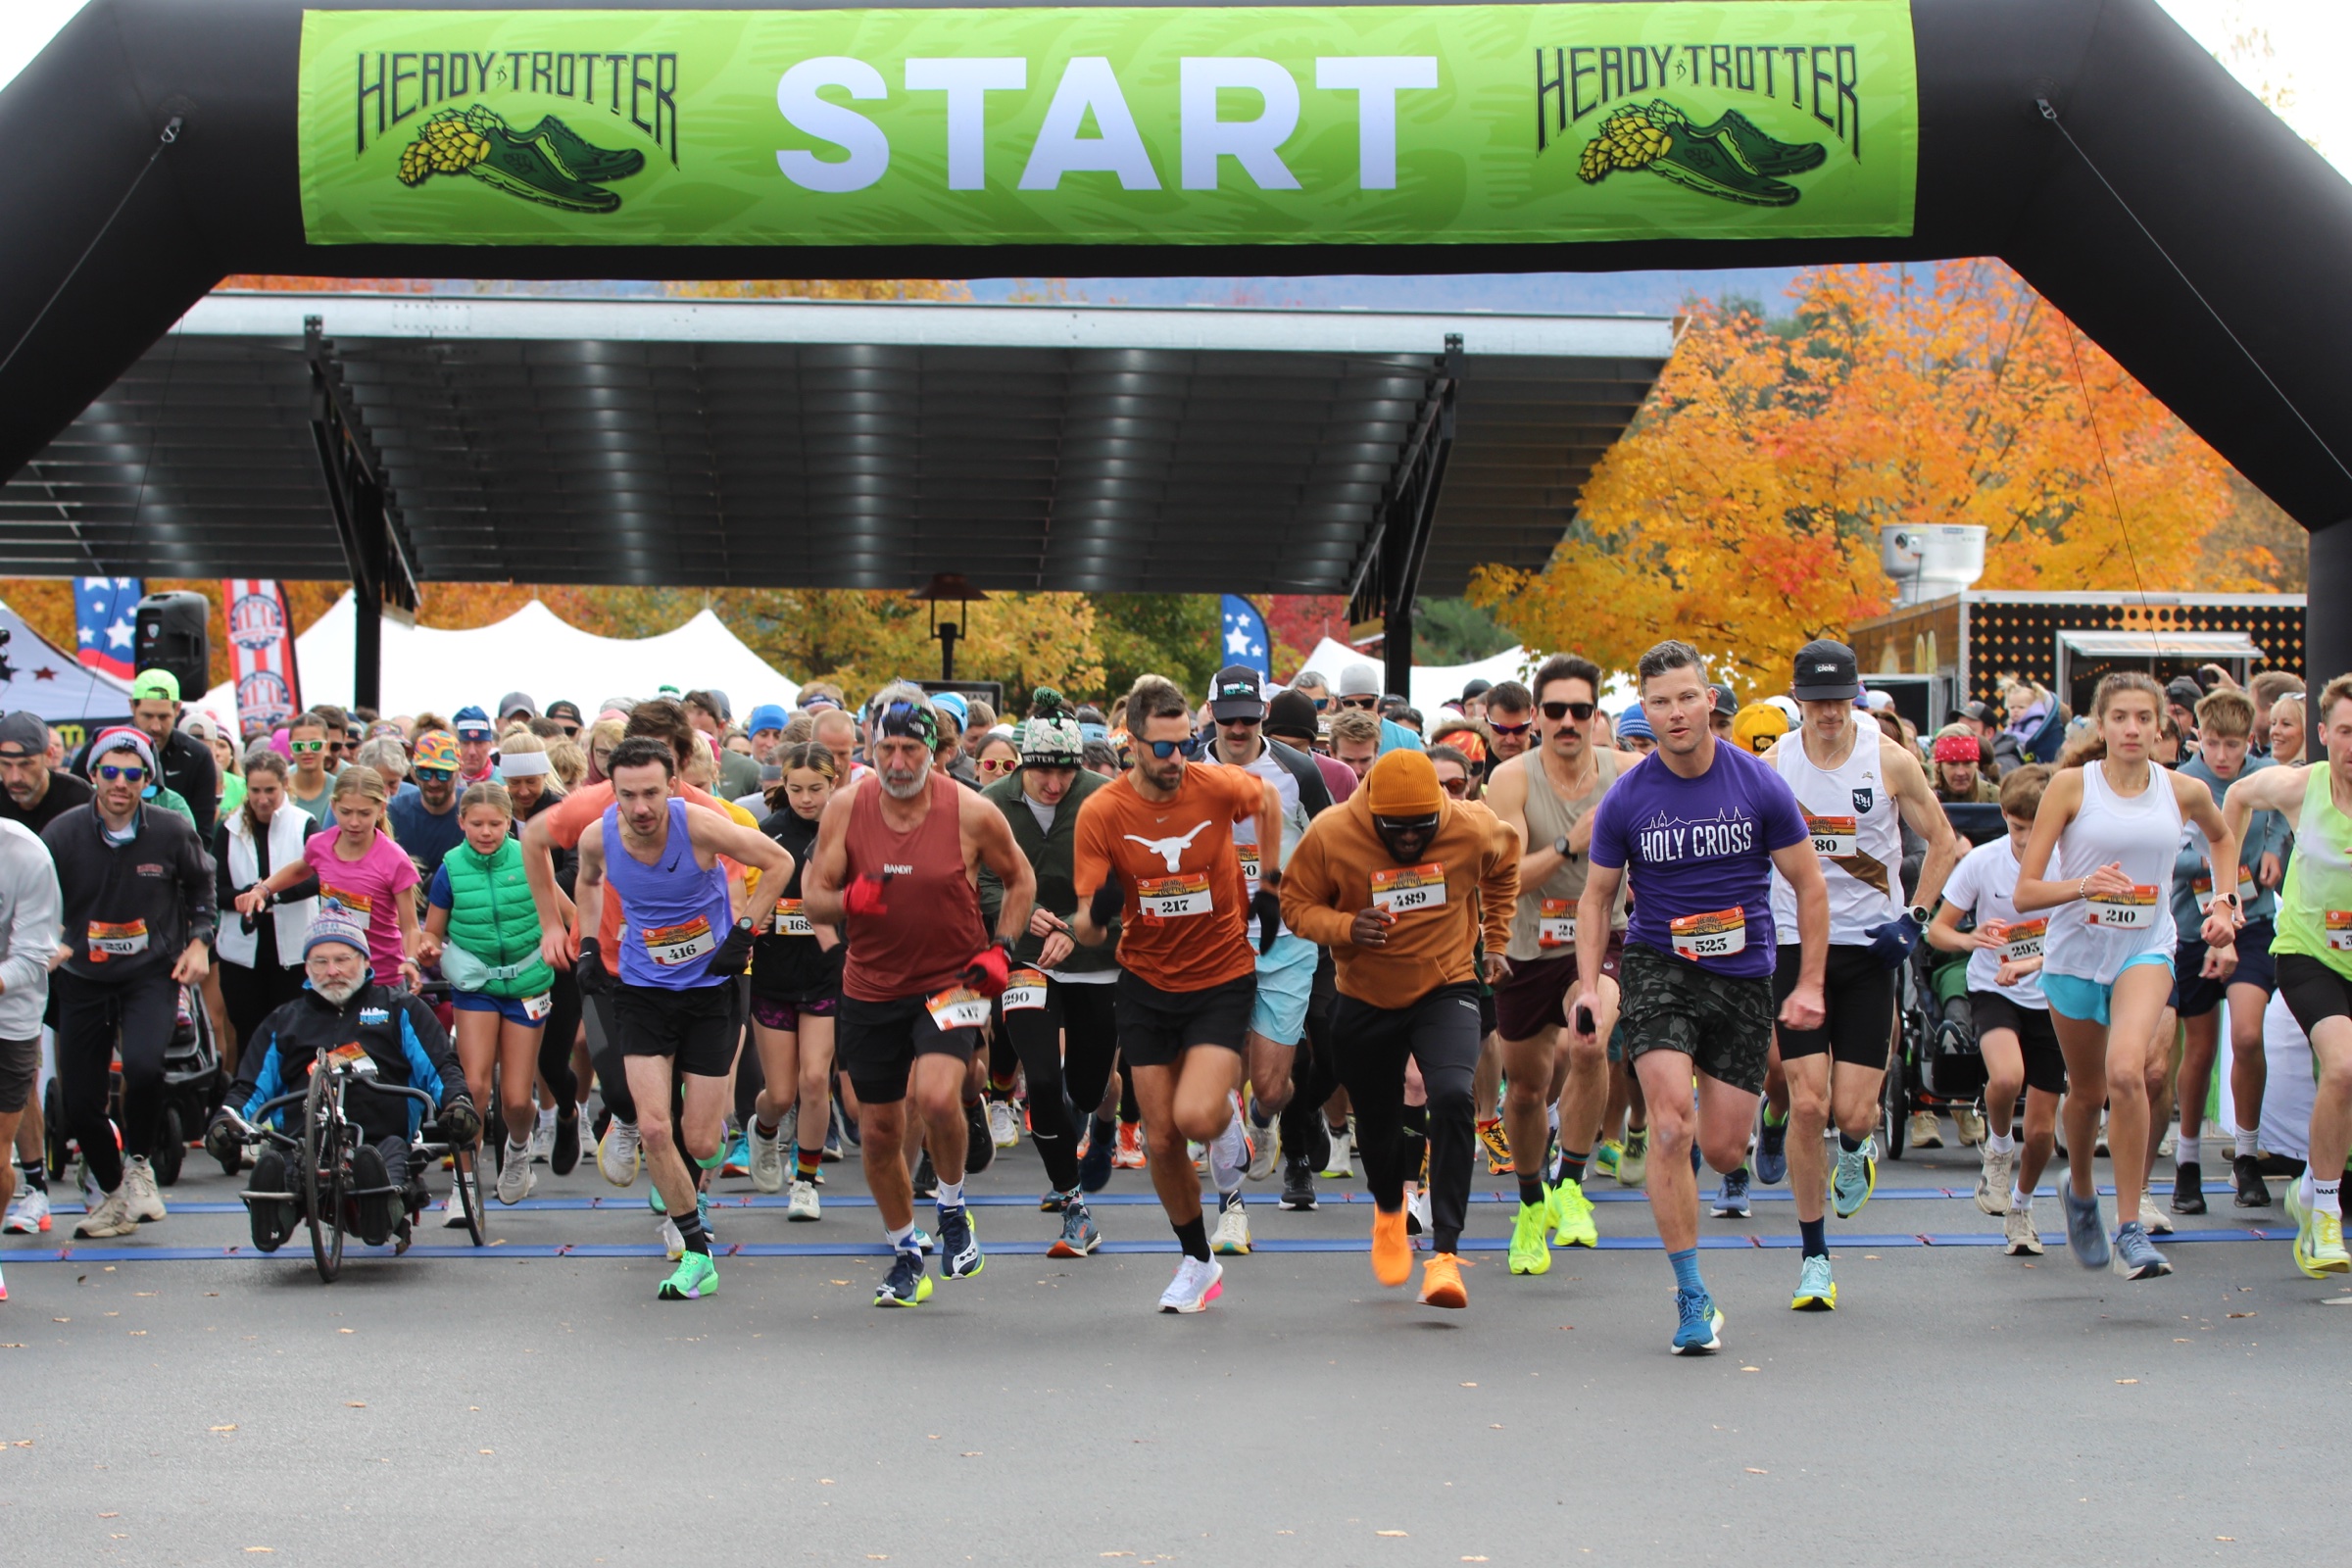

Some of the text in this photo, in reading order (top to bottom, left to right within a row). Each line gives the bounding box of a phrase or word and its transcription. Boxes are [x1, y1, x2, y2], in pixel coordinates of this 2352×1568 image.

[356, 51, 680, 172] HEADY TROTTER
[1535, 44, 1861, 166] HEADY TROTTER
[775, 56, 1439, 193] START
[1817, 663, 1836, 672] ciele
[1641, 821, 1752, 862] HOLY CROSS
[1811, 838, 1838, 853] 80
[883, 862, 913, 874] BANDIT
[1161, 899, 1190, 913] 217
[1394, 891, 1427, 907] 489
[2106, 908, 2136, 923] 210
[789, 919, 812, 931] 168
[668, 944, 697, 960] 416
[1694, 937, 1728, 953] 523
[2011, 941, 2040, 957] 293
[1003, 991, 1030, 1006] 290
